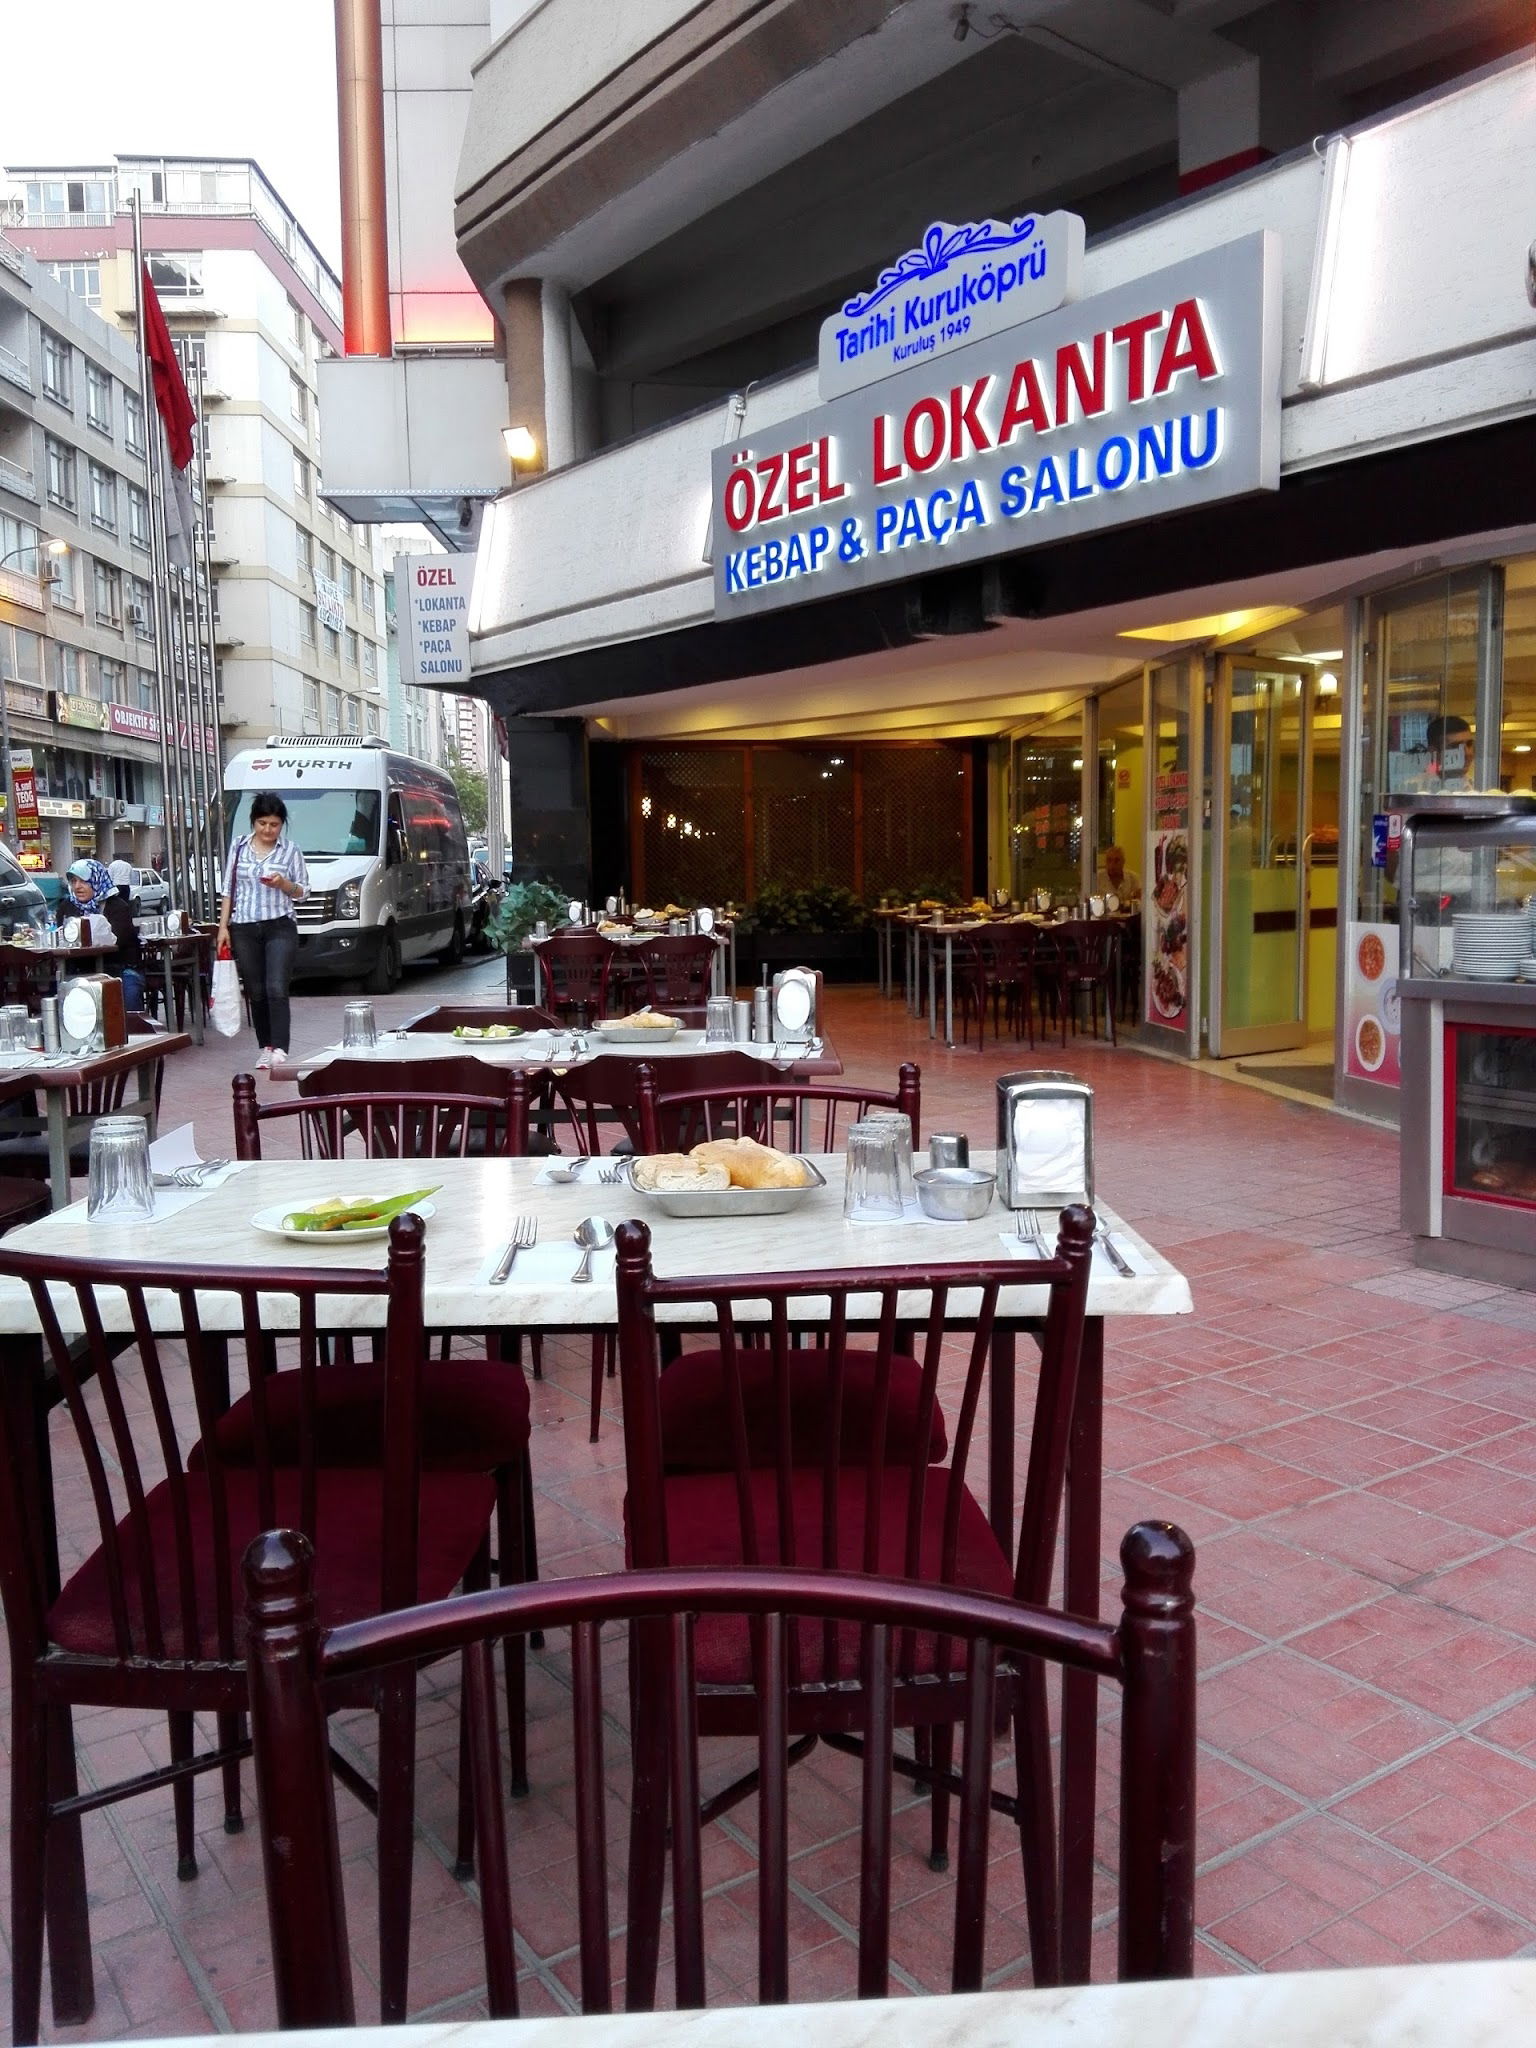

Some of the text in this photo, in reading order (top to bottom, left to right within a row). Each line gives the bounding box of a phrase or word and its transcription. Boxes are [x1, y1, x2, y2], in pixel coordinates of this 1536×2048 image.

[836, 240, 1047, 362] Tarihi Kuruköprü
[893, 315, 971, 362] Kuruluş 1949
[724, 297, 1221, 533] ÖZEL LOKANTA
[725, 407, 1221, 593] KEBAP & PAÇA SALONU
[417, 566, 456, 586] ÖZEL
[420, 660, 462, 673] SALONU
[114, 709, 148, 729] OBJEKTİF
[277, 759, 352, 770] WÜRTH
[16, 790, 34, 803] TEOG
